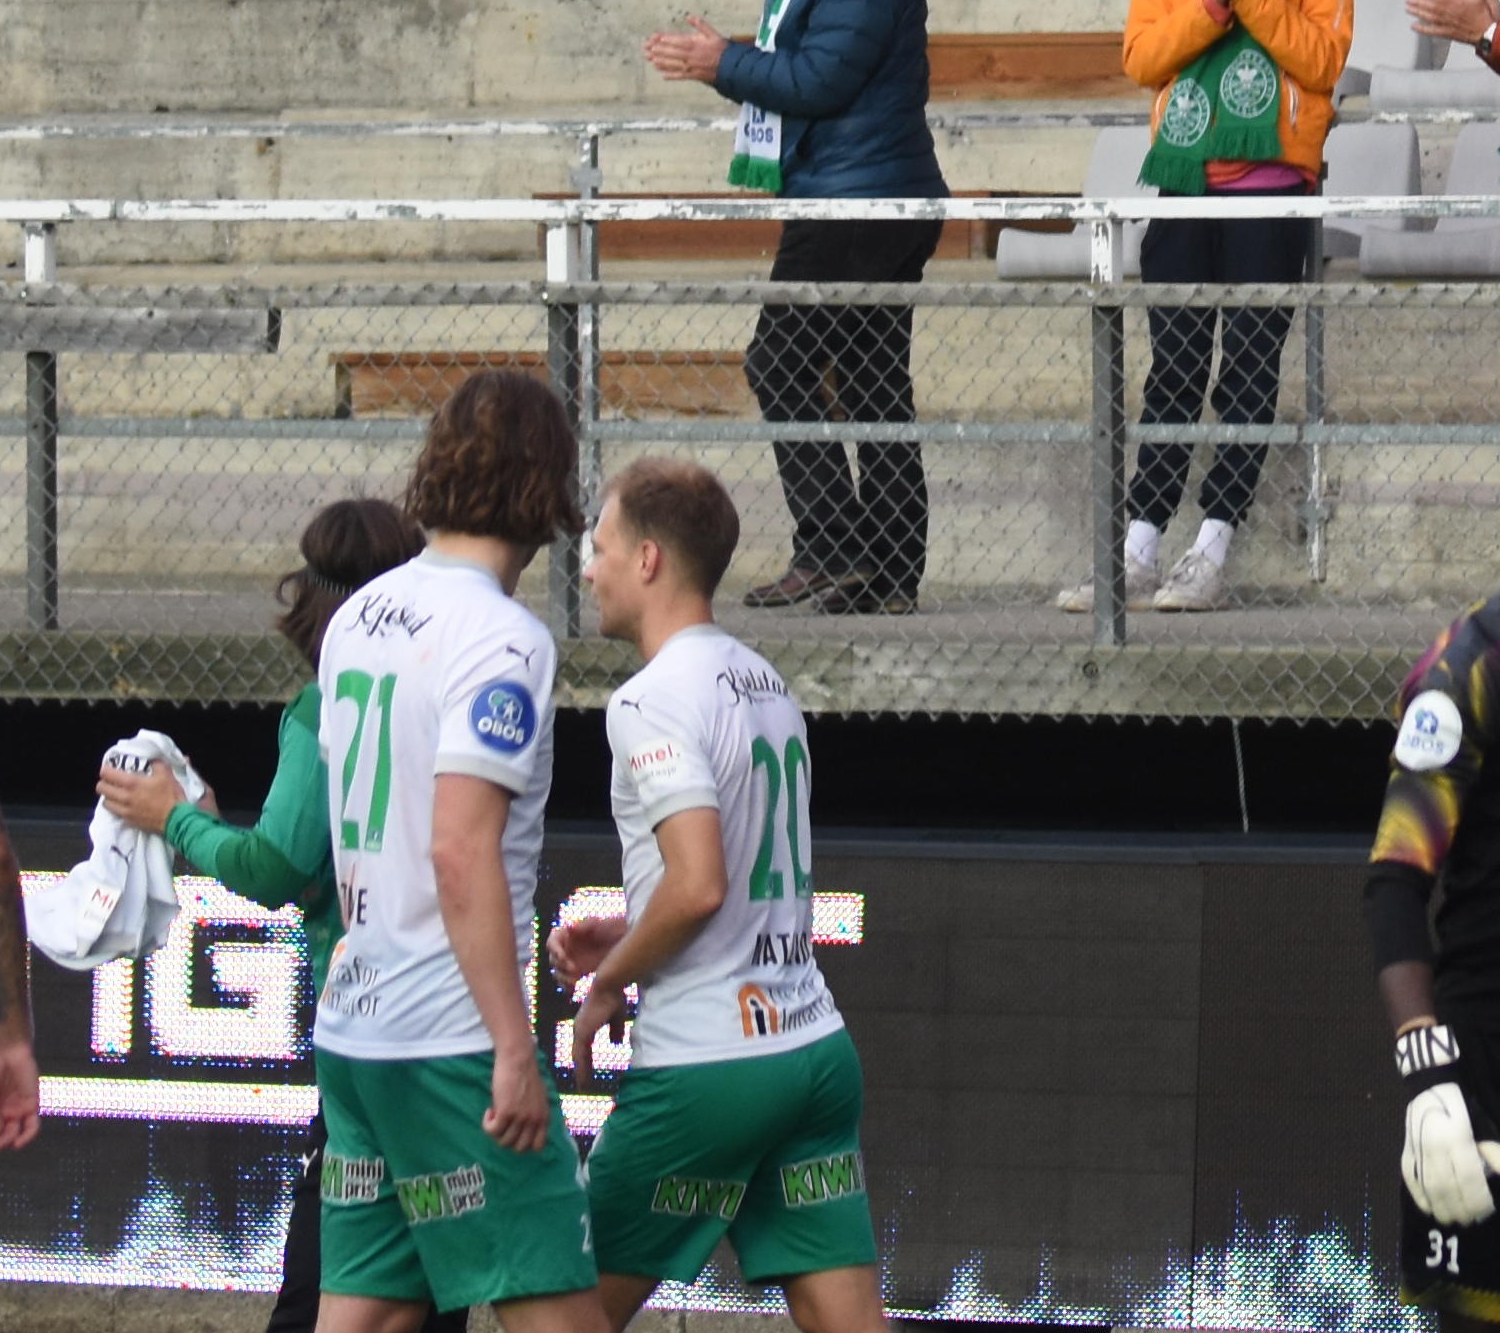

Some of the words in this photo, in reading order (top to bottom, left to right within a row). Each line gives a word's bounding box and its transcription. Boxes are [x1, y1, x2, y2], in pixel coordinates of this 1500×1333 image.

[477, 716, 525, 746] OBOS
[335, 668, 398, 854] 21
[344, 1157, 384, 1181] mini
[445, 1164, 487, 1190] mini
[344, 1179, 379, 1202] pris
[450, 1189, 486, 1217] pris
[652, 1178, 746, 1222] KIWI
[1425, 1227, 1460, 1275] 31
